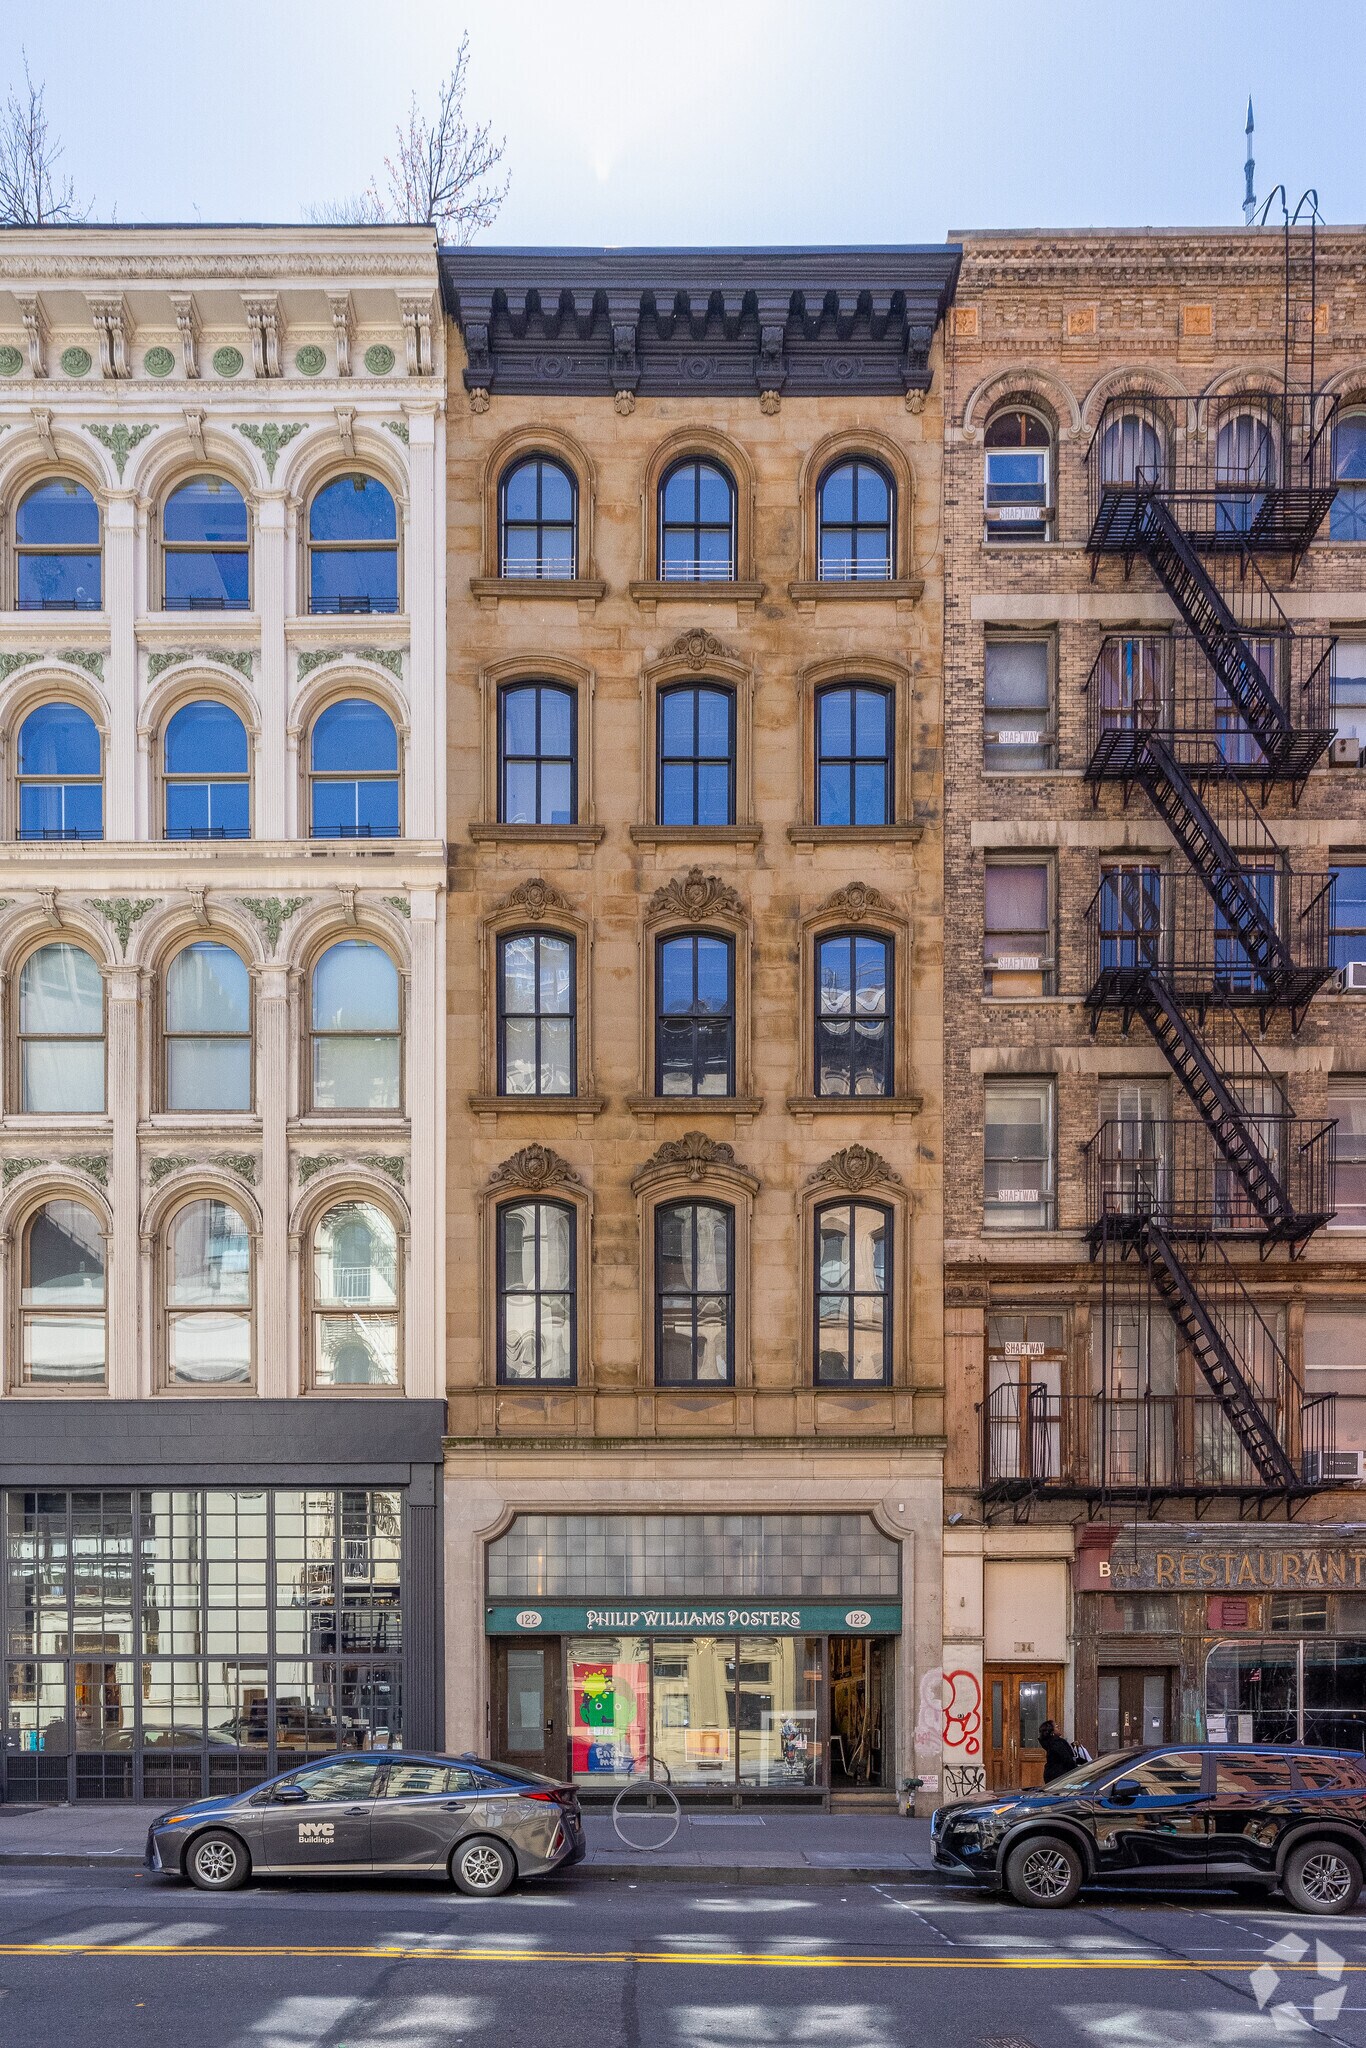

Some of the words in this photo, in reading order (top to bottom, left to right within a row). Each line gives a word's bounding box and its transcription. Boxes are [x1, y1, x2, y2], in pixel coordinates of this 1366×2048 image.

[1000, 507, 1039, 519] SHAFTWAY
[999, 731, 1038, 743] SHAFTWAY
[999, 957, 1038, 969] SHAFTWAY
[999, 1190, 1037, 1201] SHAFTWAY
[1005, 1342, 1044, 1354] SHAFTWAY
[1099, 1561, 1141, 1578] BAR
[1155, 1552, 1366, 1585] RESTAURANT
[520, 1614, 538, 1625] 122
[586, 1610, 640, 1630] PHILIP
[640, 1610, 725, 1627] WILLIAMS
[727, 1610, 801, 1629] POSTERS
[849, 1613, 867, 1625] 122
[298, 1823, 335, 1836] NYC
[298, 1836, 335, 1844] Buildings
